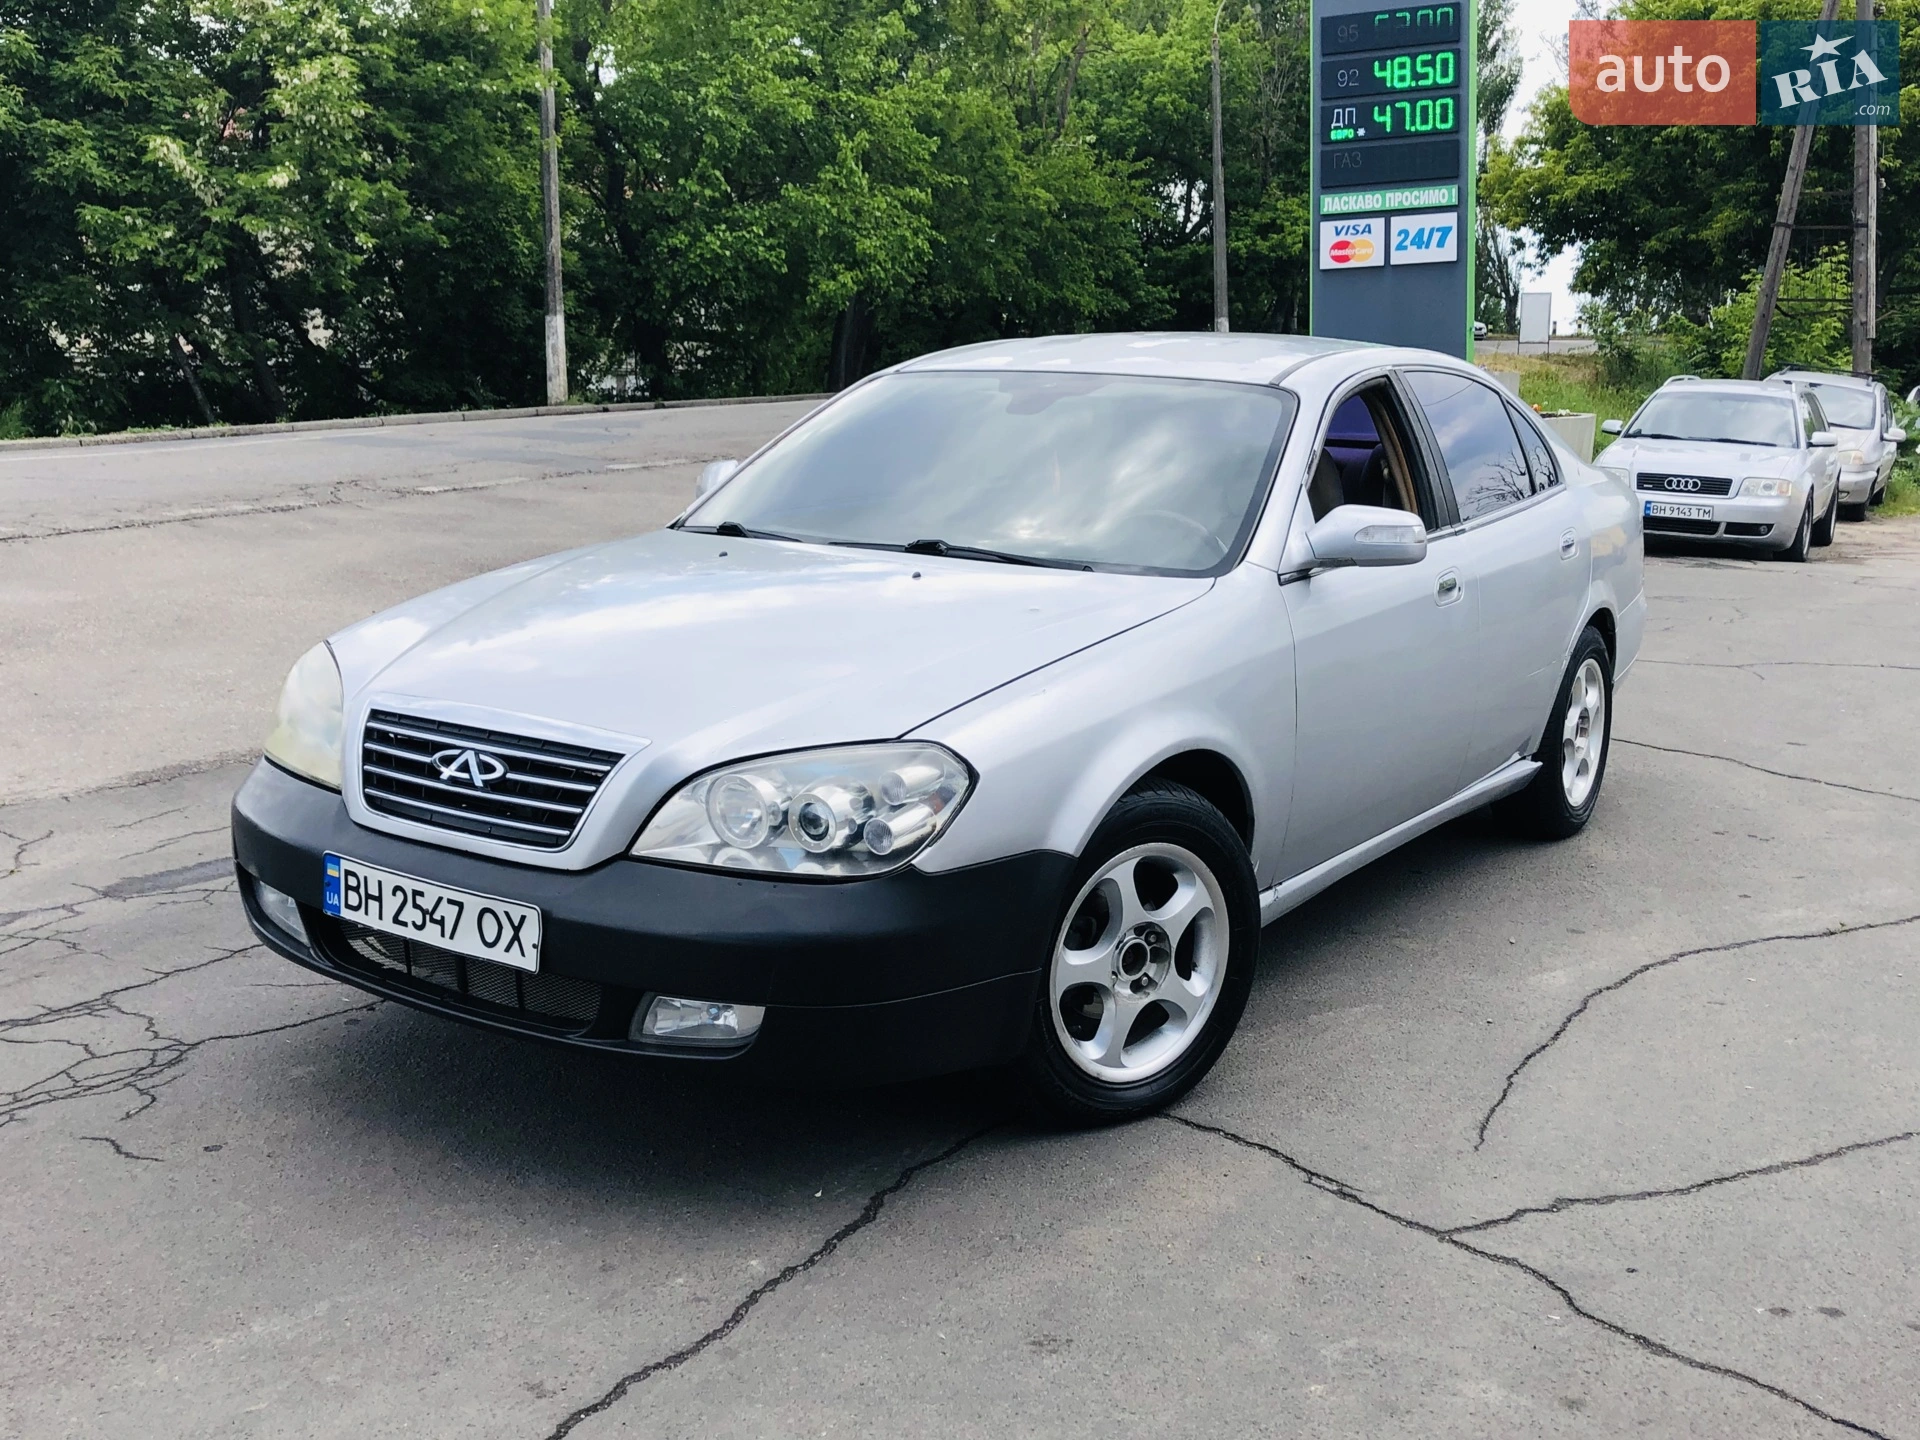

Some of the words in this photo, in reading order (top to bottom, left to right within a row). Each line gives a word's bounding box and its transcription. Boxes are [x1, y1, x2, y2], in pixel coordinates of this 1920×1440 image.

[1337, 24, 1359, 42] 95
[1337, 69, 1359, 87] 92
[1374, 52, 1454, 88] 48.50
[1331, 107, 1356, 129] ДП
[1374, 98, 1453, 132] 47.00
[1333, 151, 1362, 169] ГАЗ
[1323, 194, 1382, 212] ЛАСКАВО
[1386, 188, 1449, 207] ПРОСИМО
[1334, 224, 1372, 236] VISA
[1394, 226, 1453, 251] 24/7
[1330, 247, 1373, 256] MasterCard
[1652, 505, 1667, 515] BH
[1669, 506, 1692, 517] 9143
[1696, 508, 1711, 518] TM
[326, 891, 340, 907] UA
[344, 869, 383, 921] BH
[391, 885, 465, 940] 2547
[476, 907, 527, 957] OX
